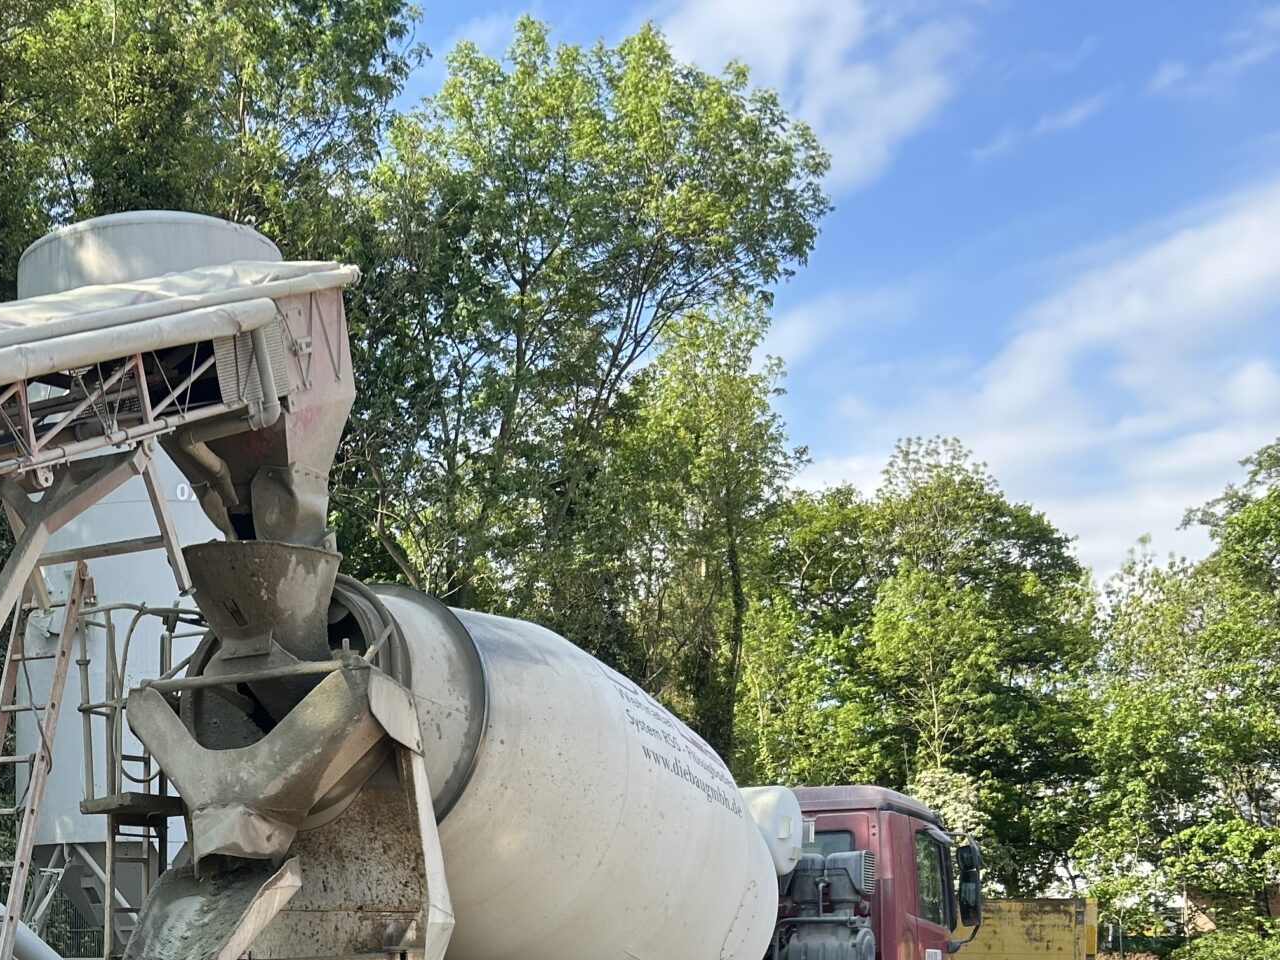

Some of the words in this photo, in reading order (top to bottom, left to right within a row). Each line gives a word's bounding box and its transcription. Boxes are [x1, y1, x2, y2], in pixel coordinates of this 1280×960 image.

[176, 483, 197, 501] 0
[625, 708, 663, 741] System
[661, 729, 681, 752] RSS
[642, 745, 743, 818] www.diebaugmbh.de
